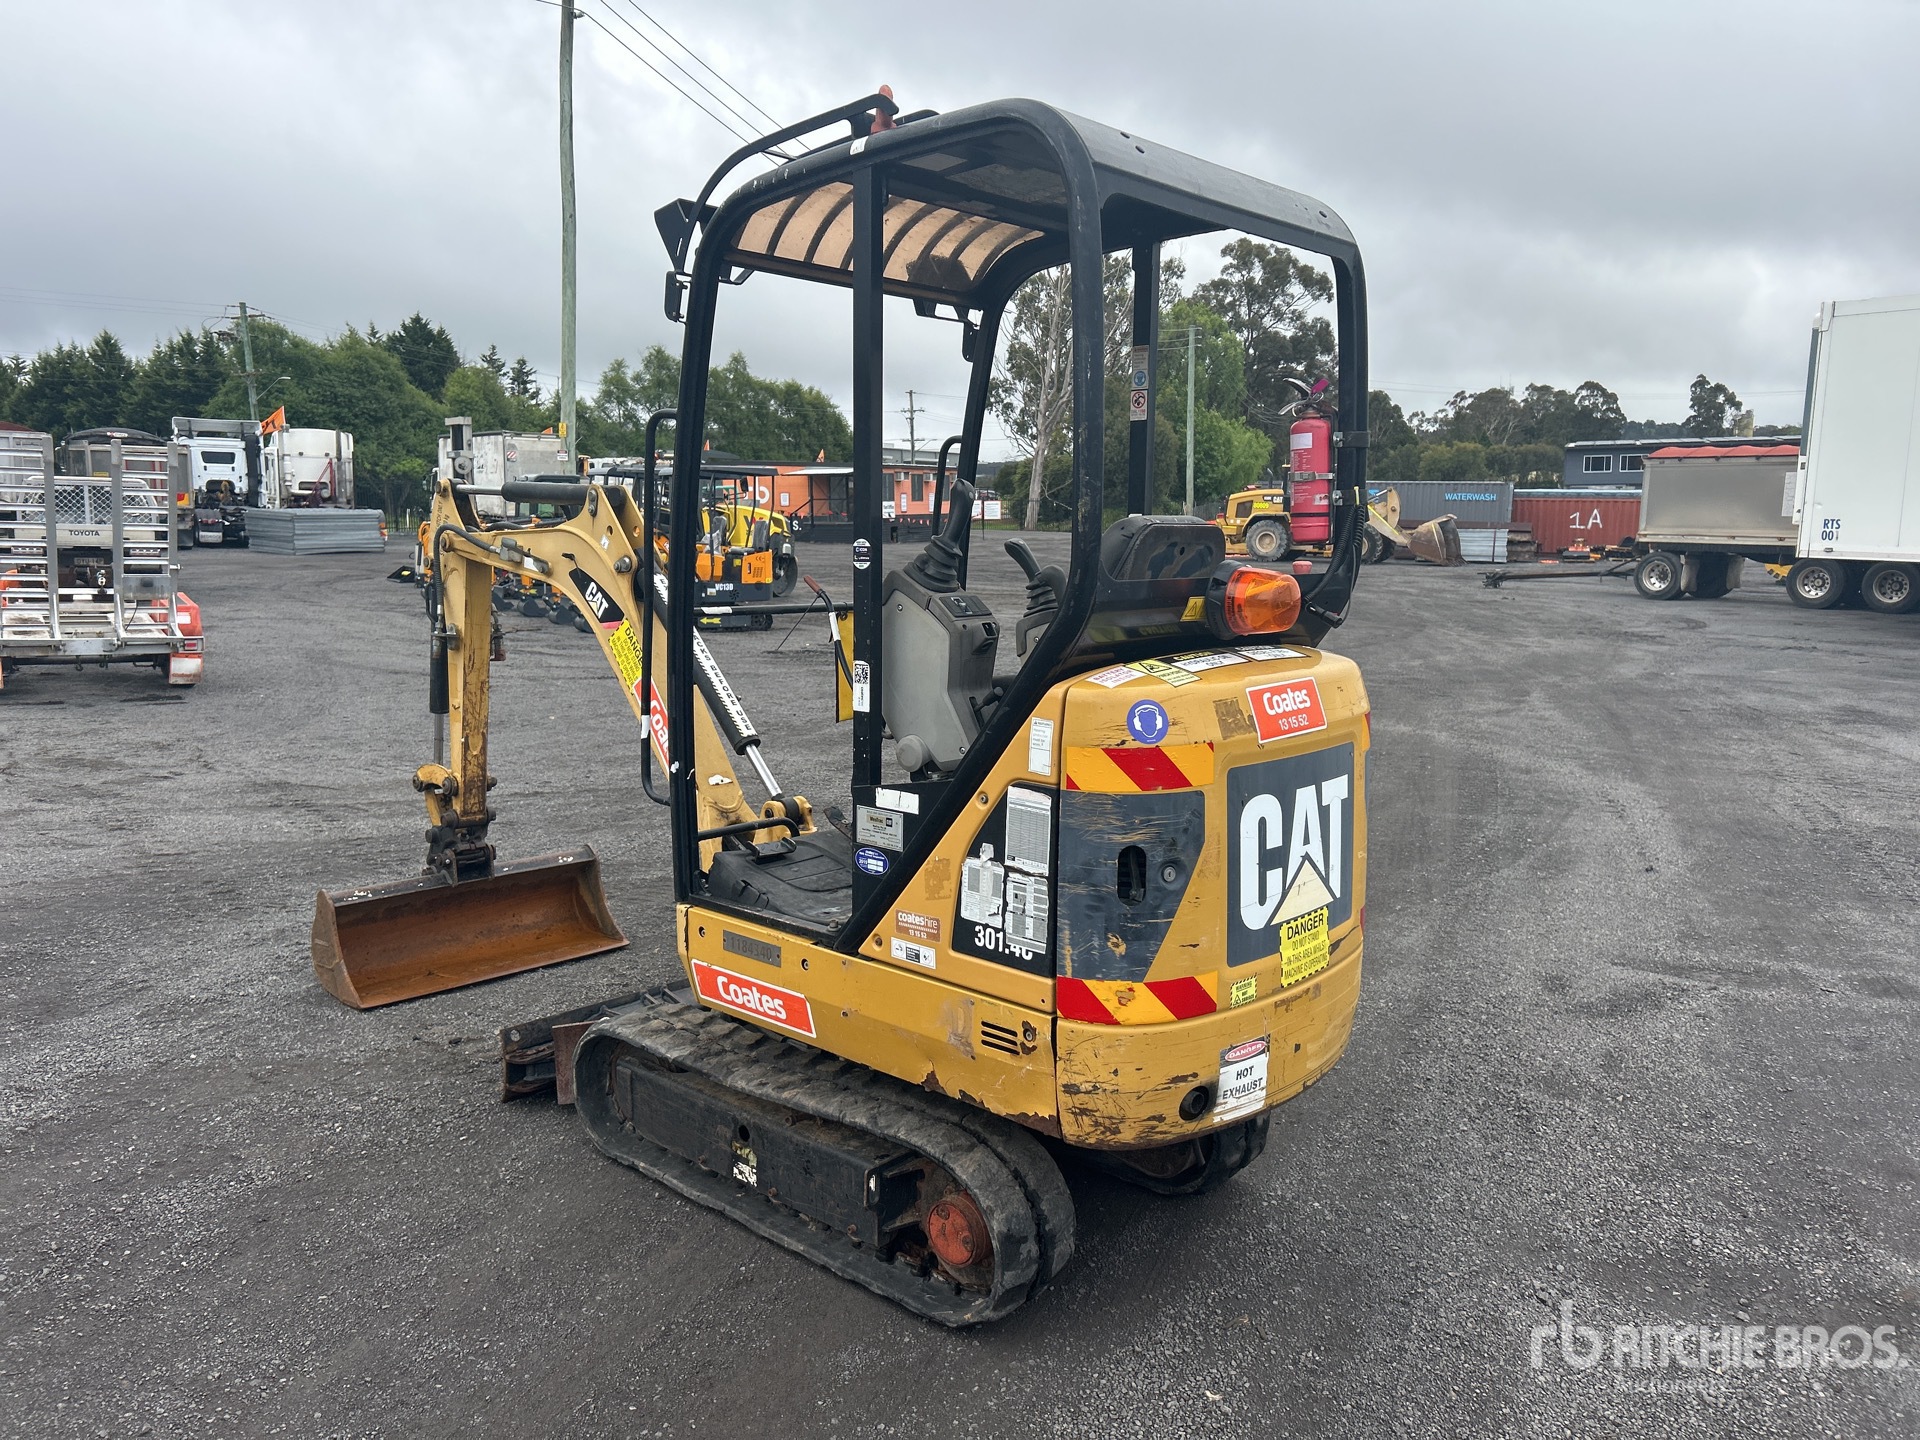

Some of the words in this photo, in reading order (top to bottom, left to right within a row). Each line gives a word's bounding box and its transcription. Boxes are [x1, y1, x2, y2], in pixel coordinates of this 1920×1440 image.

[1445, 493, 1497, 501] WATERWASH
[1823, 519, 1841, 530] RTS
[585, 582, 610, 619] CAT
[624, 627, 643, 667] DANGE
[710, 664, 737, 706] BEFORE
[735, 710, 752, 731] USE
[1262, 688, 1311, 716] Coates
[1278, 718, 1289, 731] 13
[1288, 716, 1299, 728] 15
[1298, 713, 1310, 727] 52
[1240, 774, 1349, 931] CAT
[1287, 913, 1324, 941] DANGER
[731, 937, 772, 960] 1184340
[1292, 940, 1299, 951] DO
[1299, 935, 1307, 948] NOT
[1308, 930, 1320, 944] STAND
[1284, 963, 1304, 980] MACHINE
[1308, 951, 1328, 970] OPERATING
[1292, 951, 1302, 964] THIS
[1303, 947, 1313, 960] AREA
[717, 975, 787, 1020] Coates
[1229, 1043, 1262, 1059] DANGER
[1236, 1065, 1254, 1080] HOT
[1222, 1077, 1263, 1100] EXHAUST
